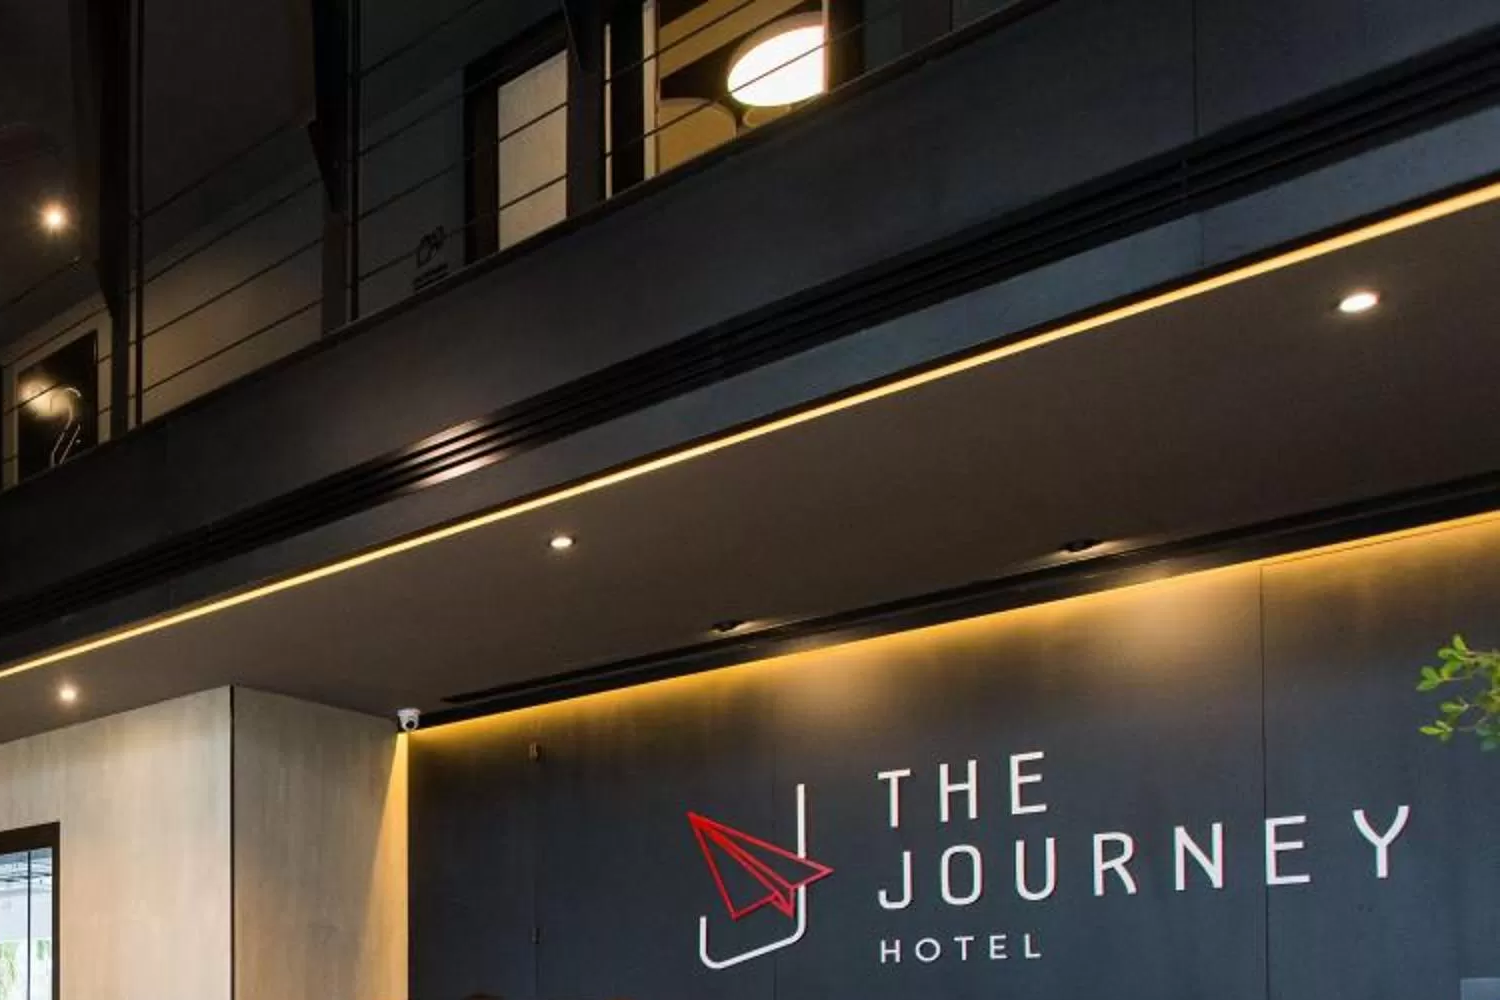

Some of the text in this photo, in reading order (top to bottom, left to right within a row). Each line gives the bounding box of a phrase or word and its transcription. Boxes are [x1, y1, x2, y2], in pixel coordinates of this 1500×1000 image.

[877, 750, 1048, 829] THE
[877, 804, 1412, 910] JOURNEY
[880, 932, 1042, 964] HOTEL
